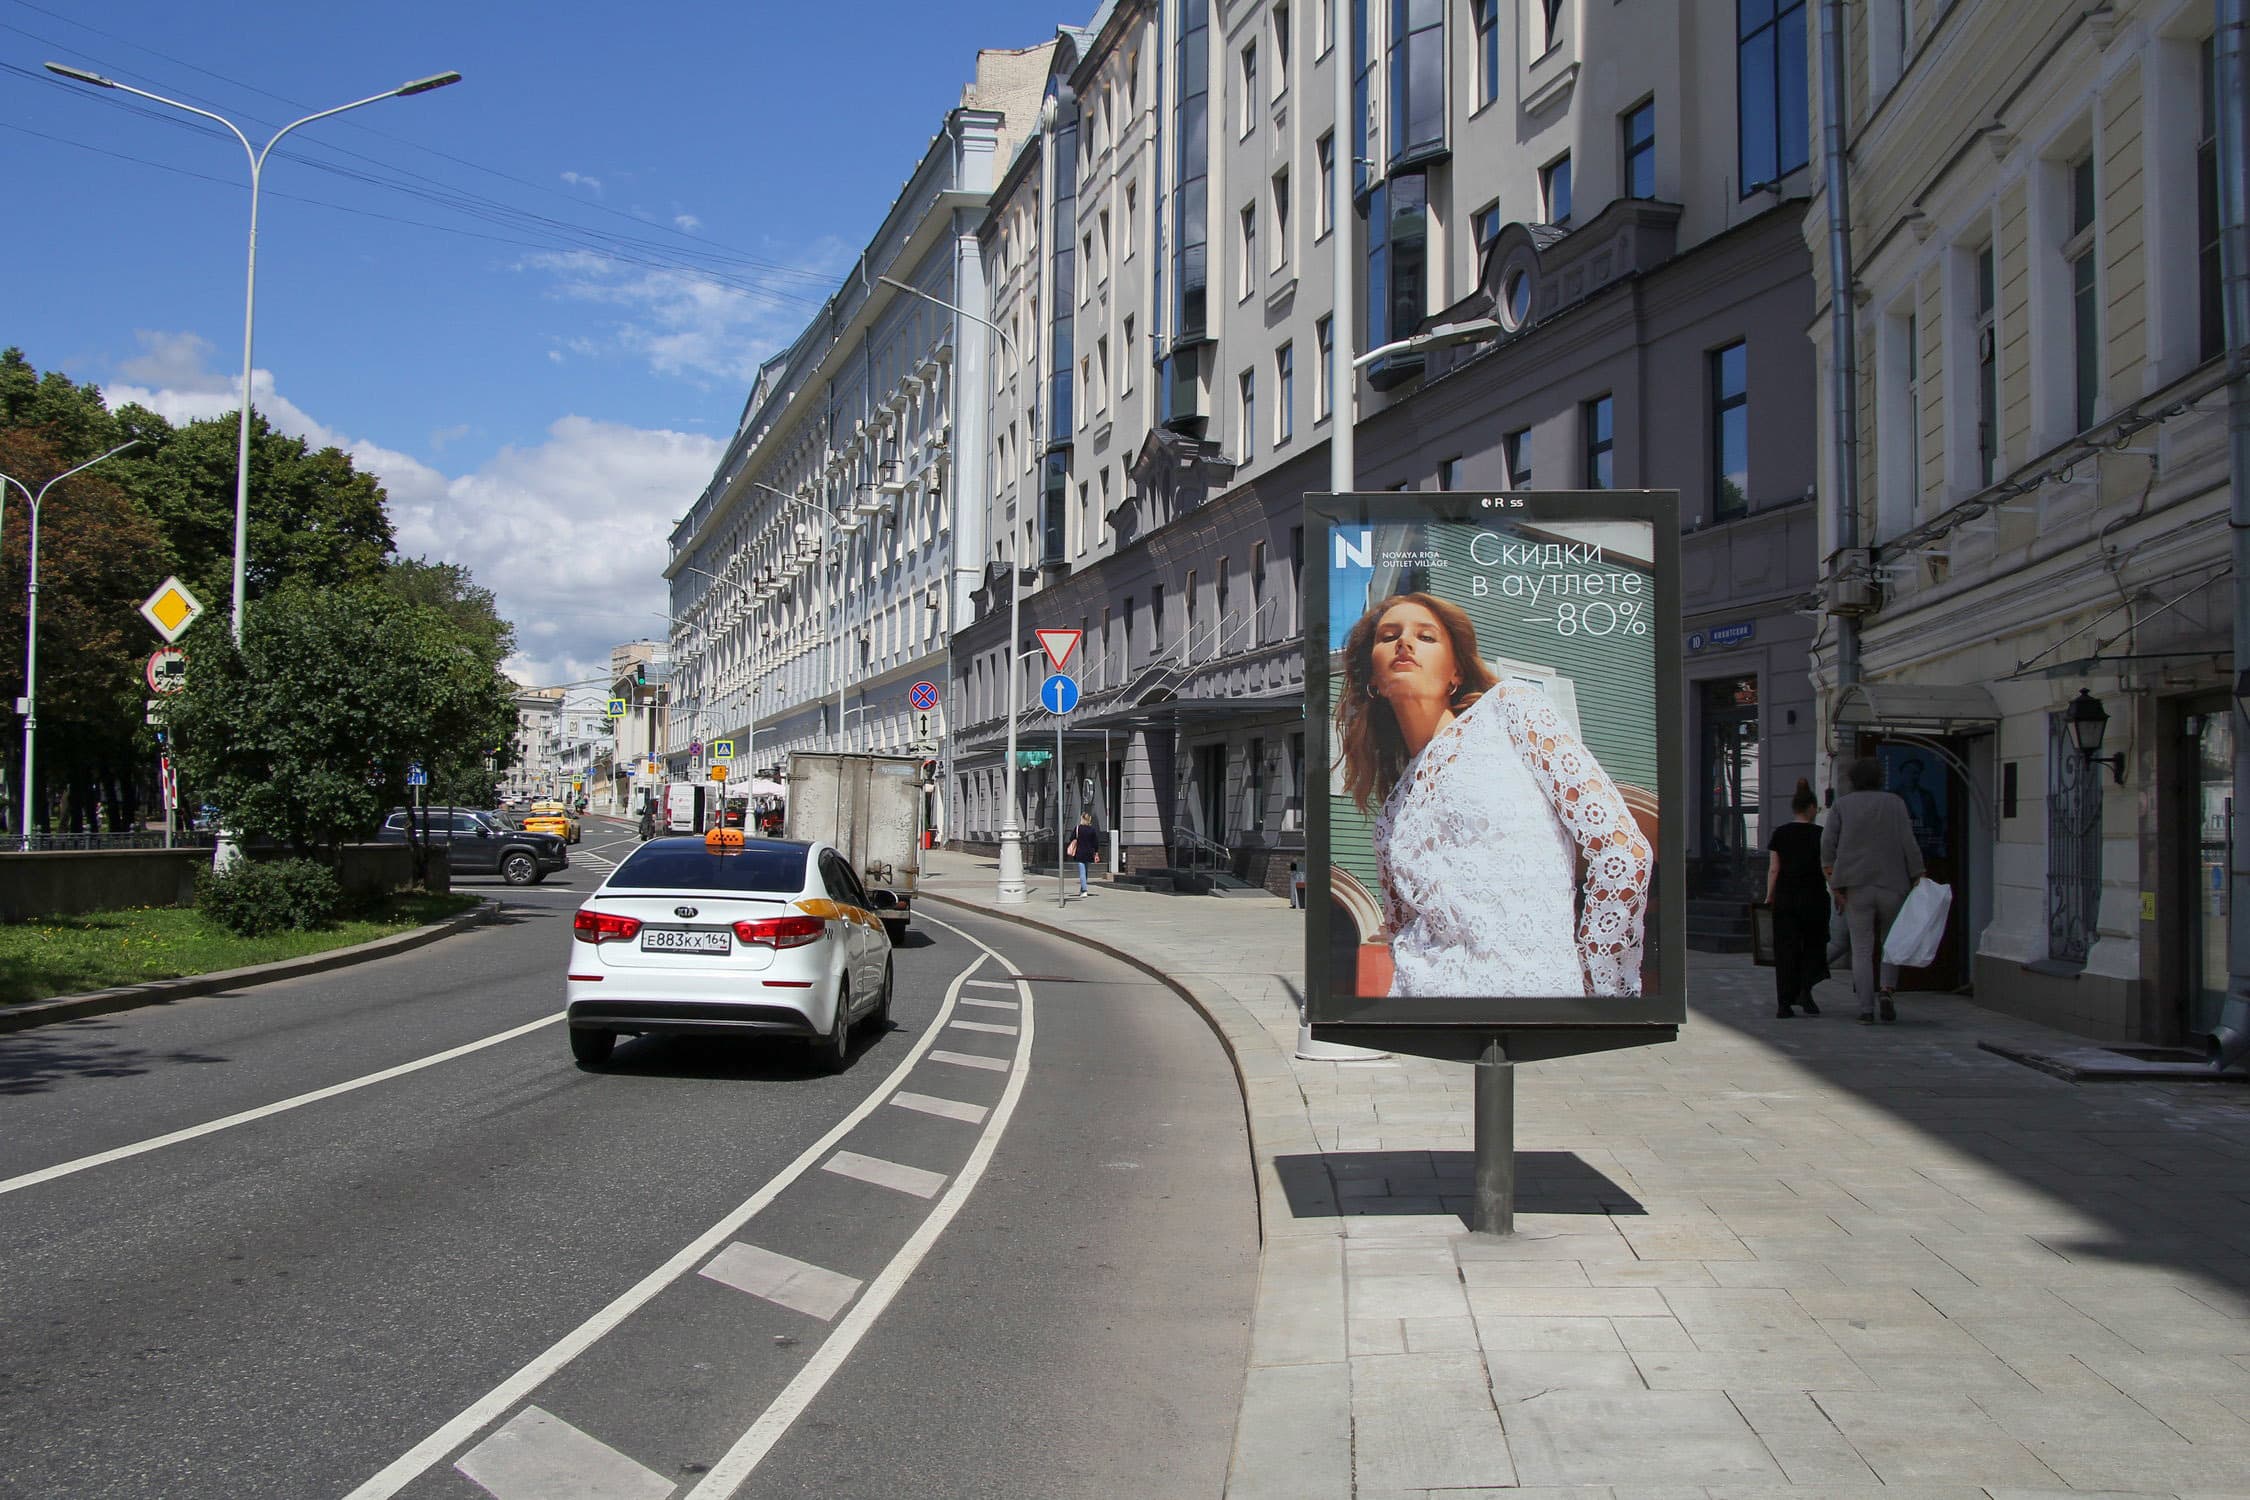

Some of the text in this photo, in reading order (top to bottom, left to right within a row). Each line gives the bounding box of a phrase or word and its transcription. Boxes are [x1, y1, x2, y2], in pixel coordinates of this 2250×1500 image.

[1382, 551, 1441, 560] NOVAYA RIGA
[1470, 532, 1602, 570] Скидки
[1382, 559, 1449, 568] OUTLET VILLAGE
[1502, 573, 1643, 607] аутлете
[1692, 636, 1701, 649] 10
[677, 908, 695, 917] KIA
[705, 933, 728, 945] 164
